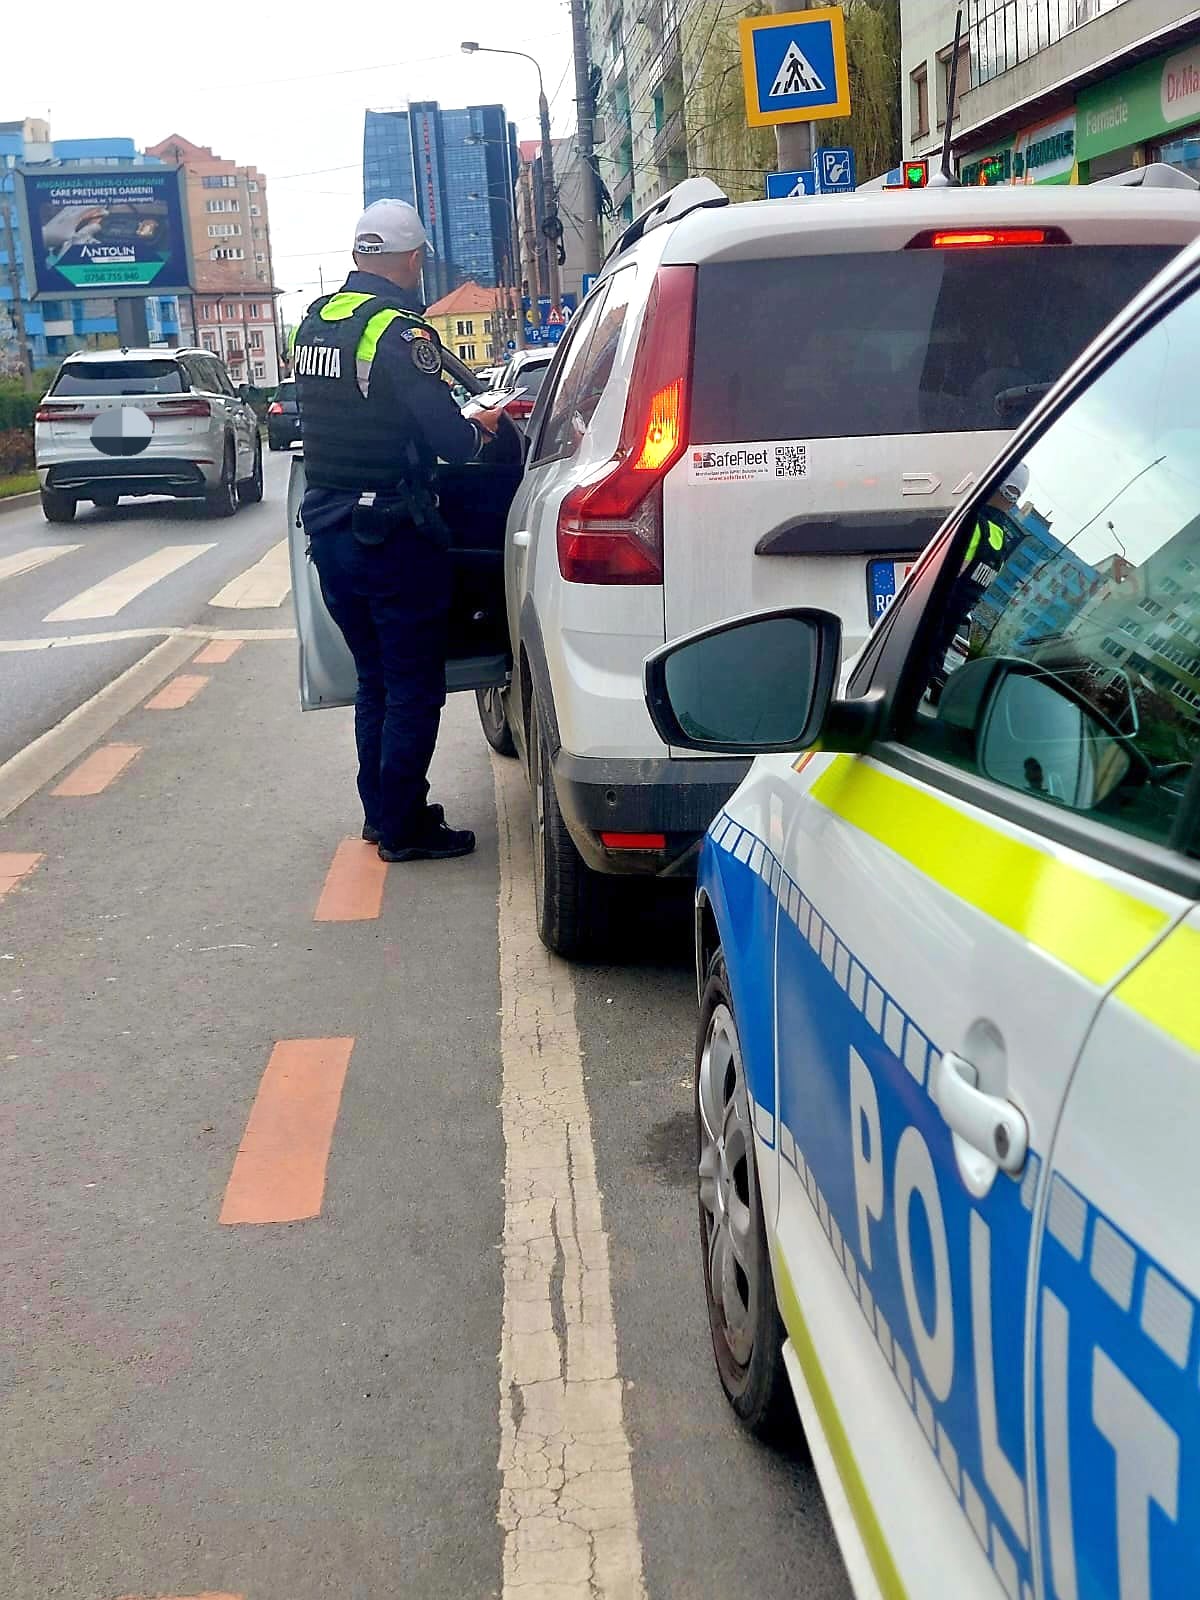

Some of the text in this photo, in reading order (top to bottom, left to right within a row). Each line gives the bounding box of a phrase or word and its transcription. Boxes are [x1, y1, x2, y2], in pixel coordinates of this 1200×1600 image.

[1086, 96, 1129, 137] Farmacie
[826, 155, 836, 170] P
[51, 188, 71, 197] CARE
[119, 186, 153, 195] OAMENII
[80, 245, 135, 257] ANTOLIN
[709, 449, 769, 467] SafeFleet
